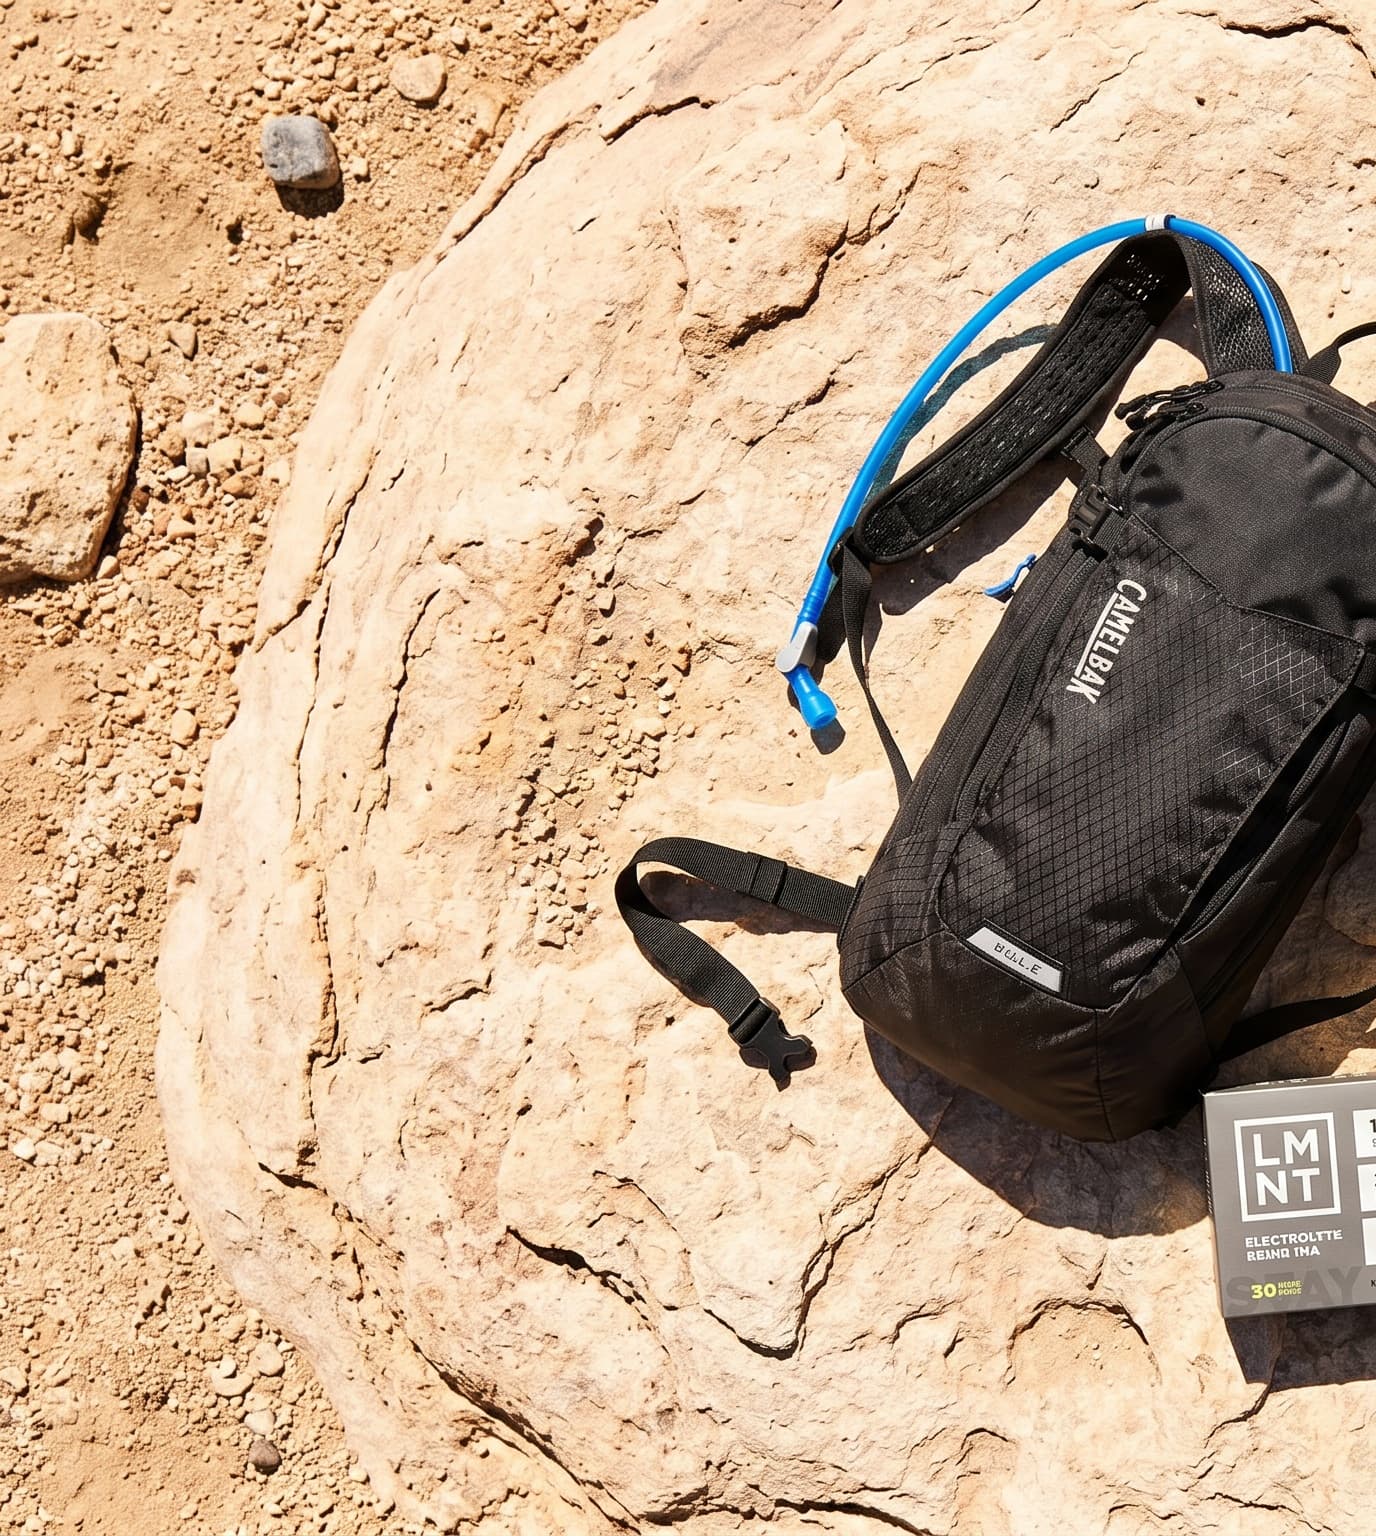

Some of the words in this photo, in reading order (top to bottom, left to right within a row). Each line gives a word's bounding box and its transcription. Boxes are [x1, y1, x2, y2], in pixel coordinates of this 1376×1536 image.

[1066, 579, 1147, 704] CAMELBAK
[1253, 1128, 1320, 1167] LM
[1256, 1168, 1321, 1206] NT
[1250, 1283, 1277, 1299] 30
